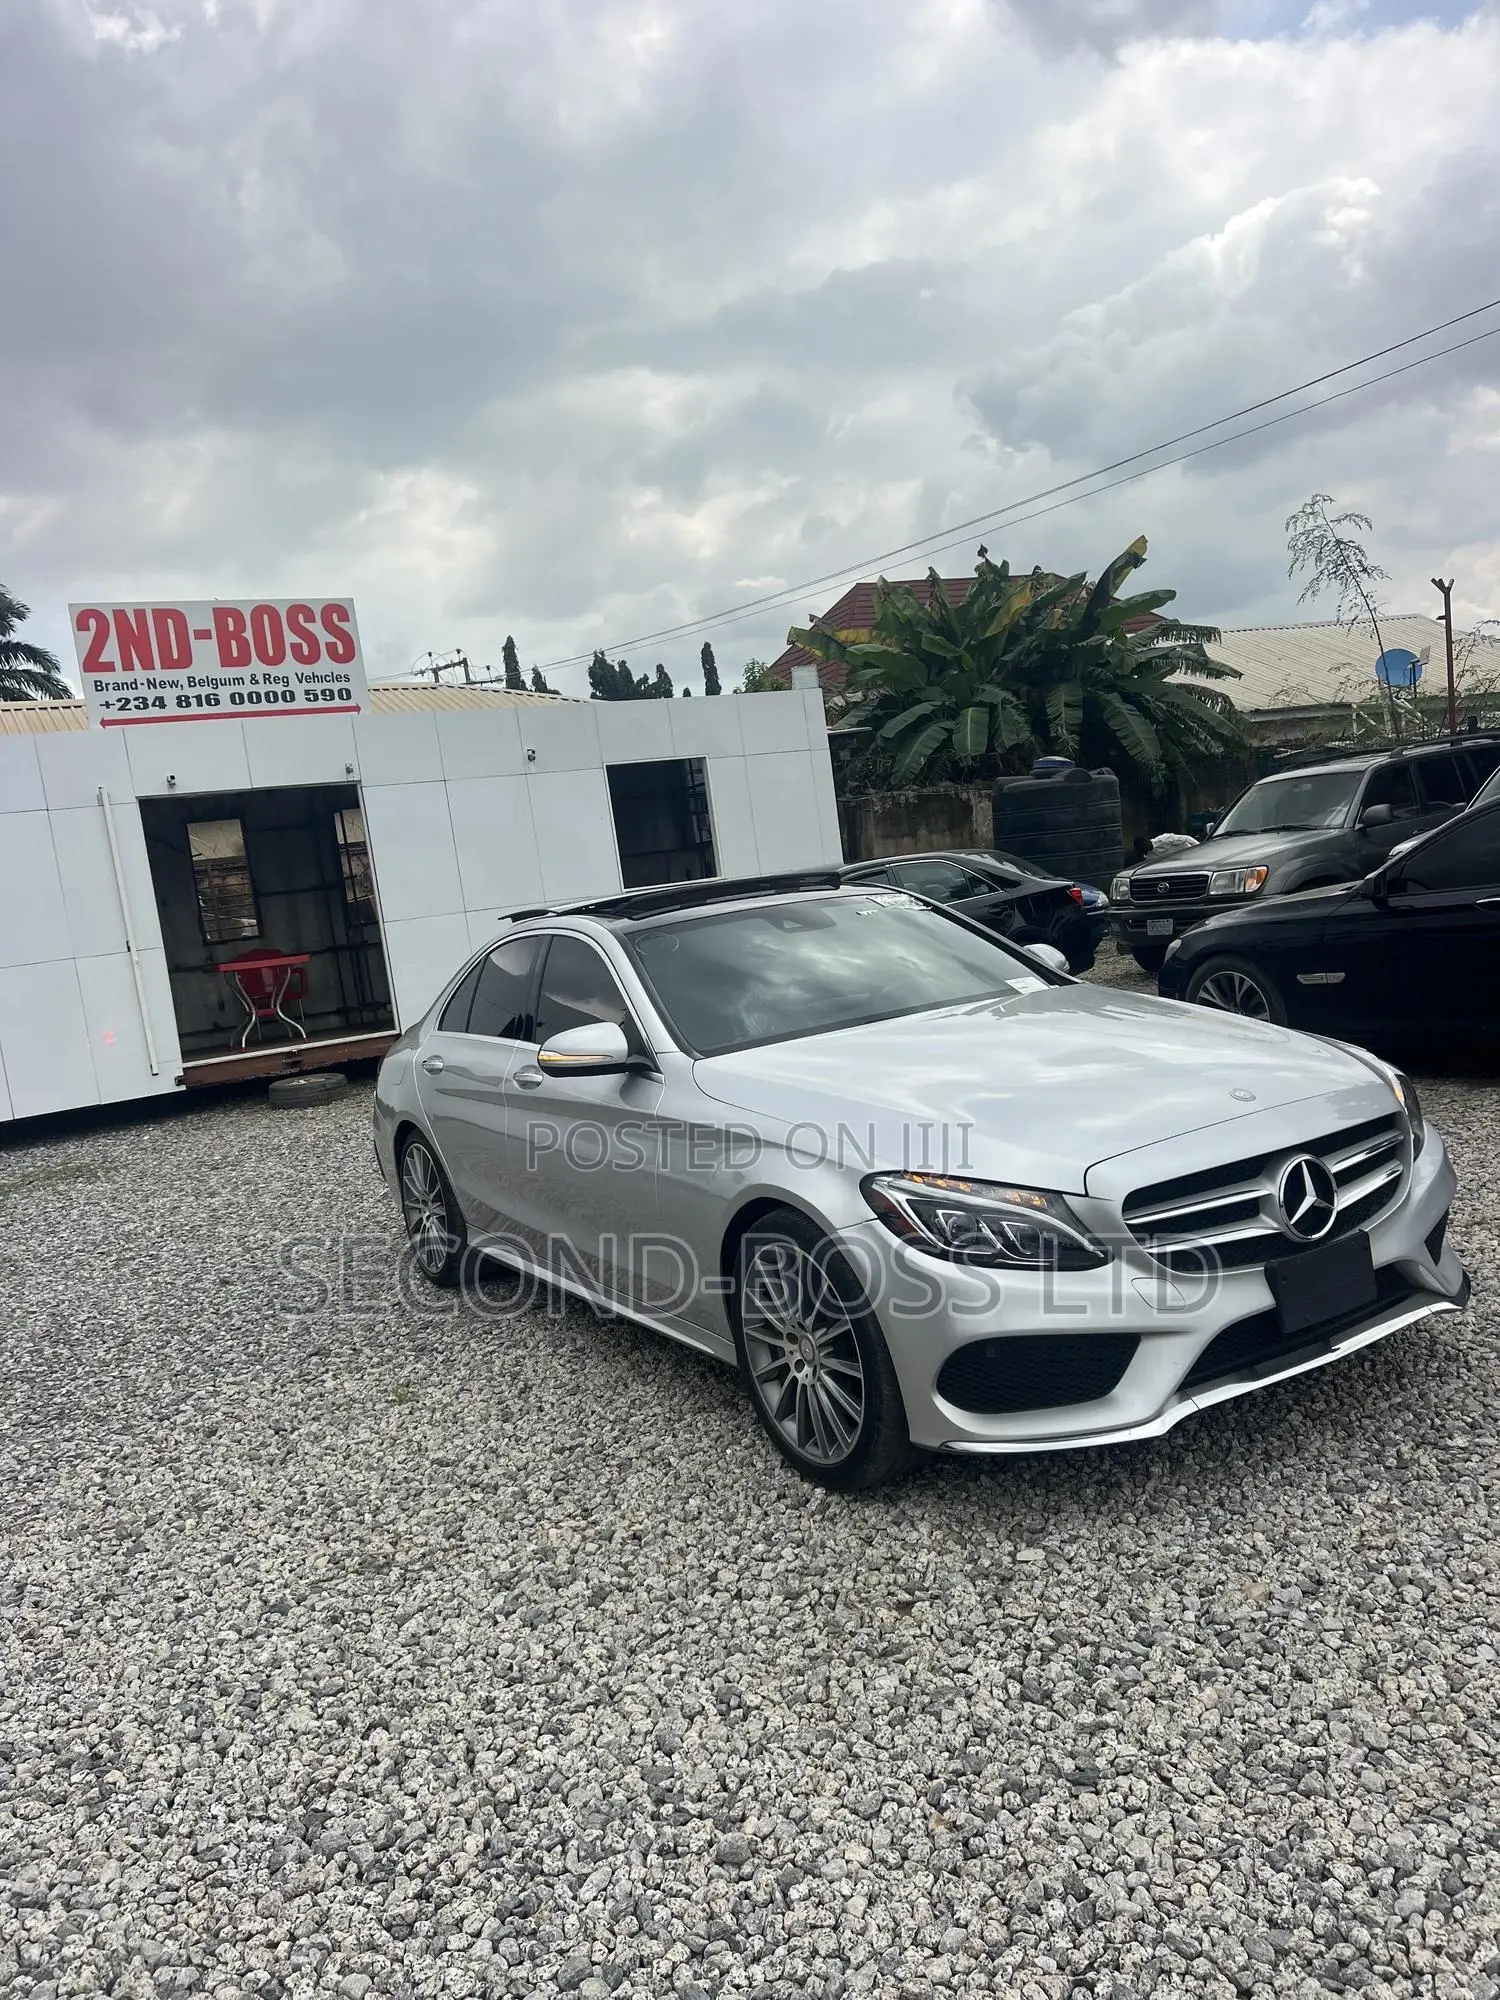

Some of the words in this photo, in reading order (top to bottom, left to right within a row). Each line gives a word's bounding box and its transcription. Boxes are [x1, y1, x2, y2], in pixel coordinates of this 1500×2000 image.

[76, 603, 355, 673] 2ND-BOSS
[187, 675, 245, 690] Belguim
[250, 673, 260, 685] &
[262, 673, 290, 688] Reg
[295, 671, 351, 684] Vehicles
[99, 696, 167, 711] +234
[176, 693, 221, 709] 816
[229, 690, 296, 706] 0000
[304, 688, 352, 703] 590
